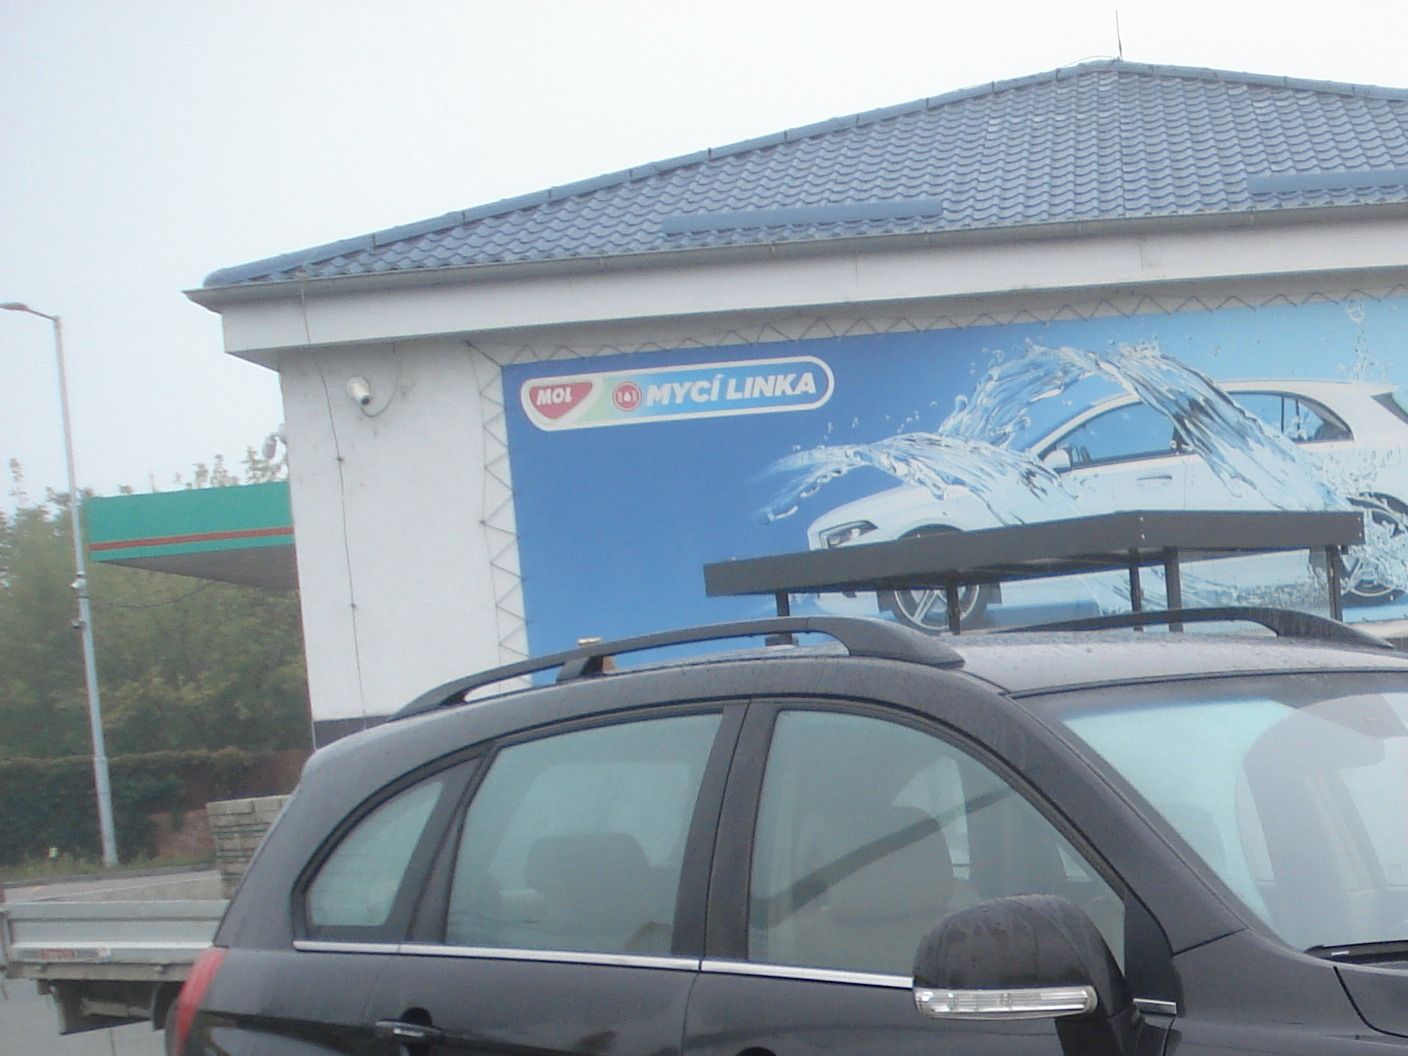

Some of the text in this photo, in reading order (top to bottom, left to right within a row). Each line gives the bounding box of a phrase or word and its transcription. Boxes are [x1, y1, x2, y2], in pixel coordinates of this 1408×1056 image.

[536, 386, 573, 406] MOL
[646, 371, 817, 407] MYCÍ LINKA
